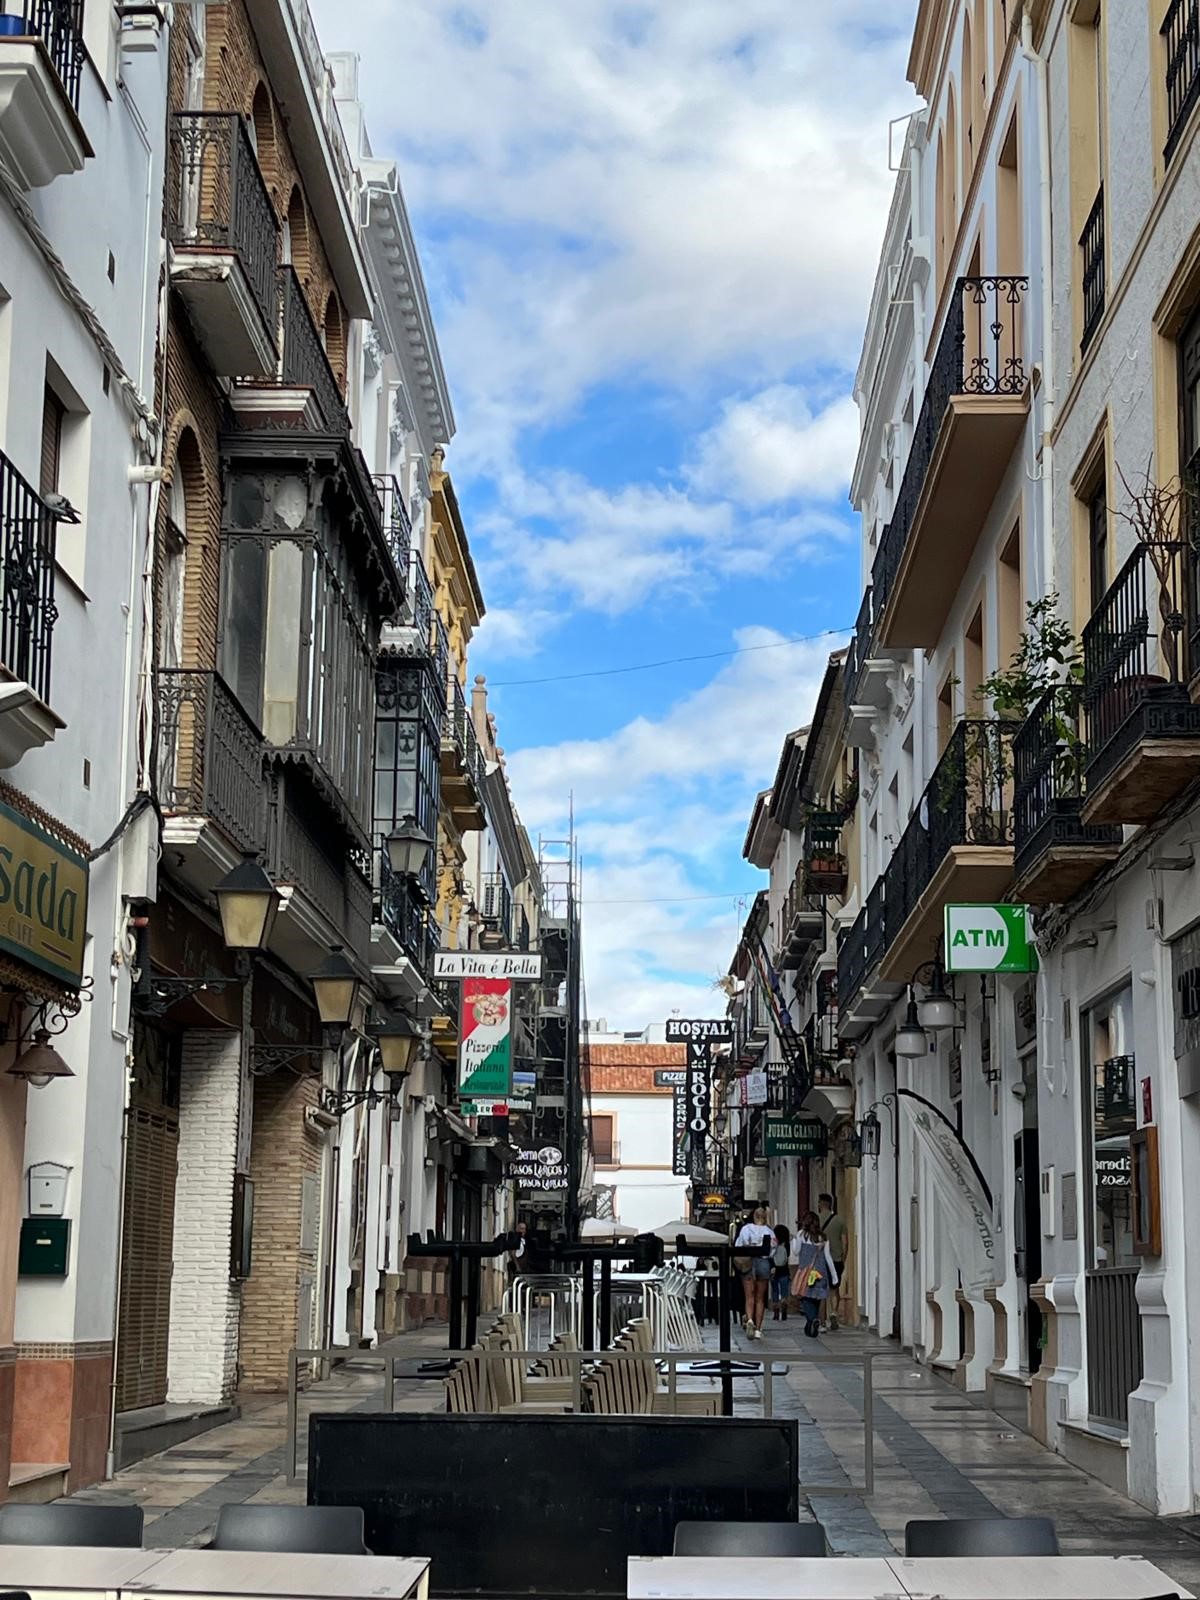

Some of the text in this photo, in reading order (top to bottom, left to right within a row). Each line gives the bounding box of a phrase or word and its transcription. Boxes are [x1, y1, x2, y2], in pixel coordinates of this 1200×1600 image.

[952, 930, 1004, 946] ATM
[438, 957, 537, 974] La Vita é Bella
[668, 1022, 730, 1036] HOSTAL
[465, 1039, 505, 1053] Pizzeria
[465, 1058, 505, 1073] Italiana
[463, 1105, 507, 1114] SALERNO
[768, 1124, 793, 1138] PUERTA
